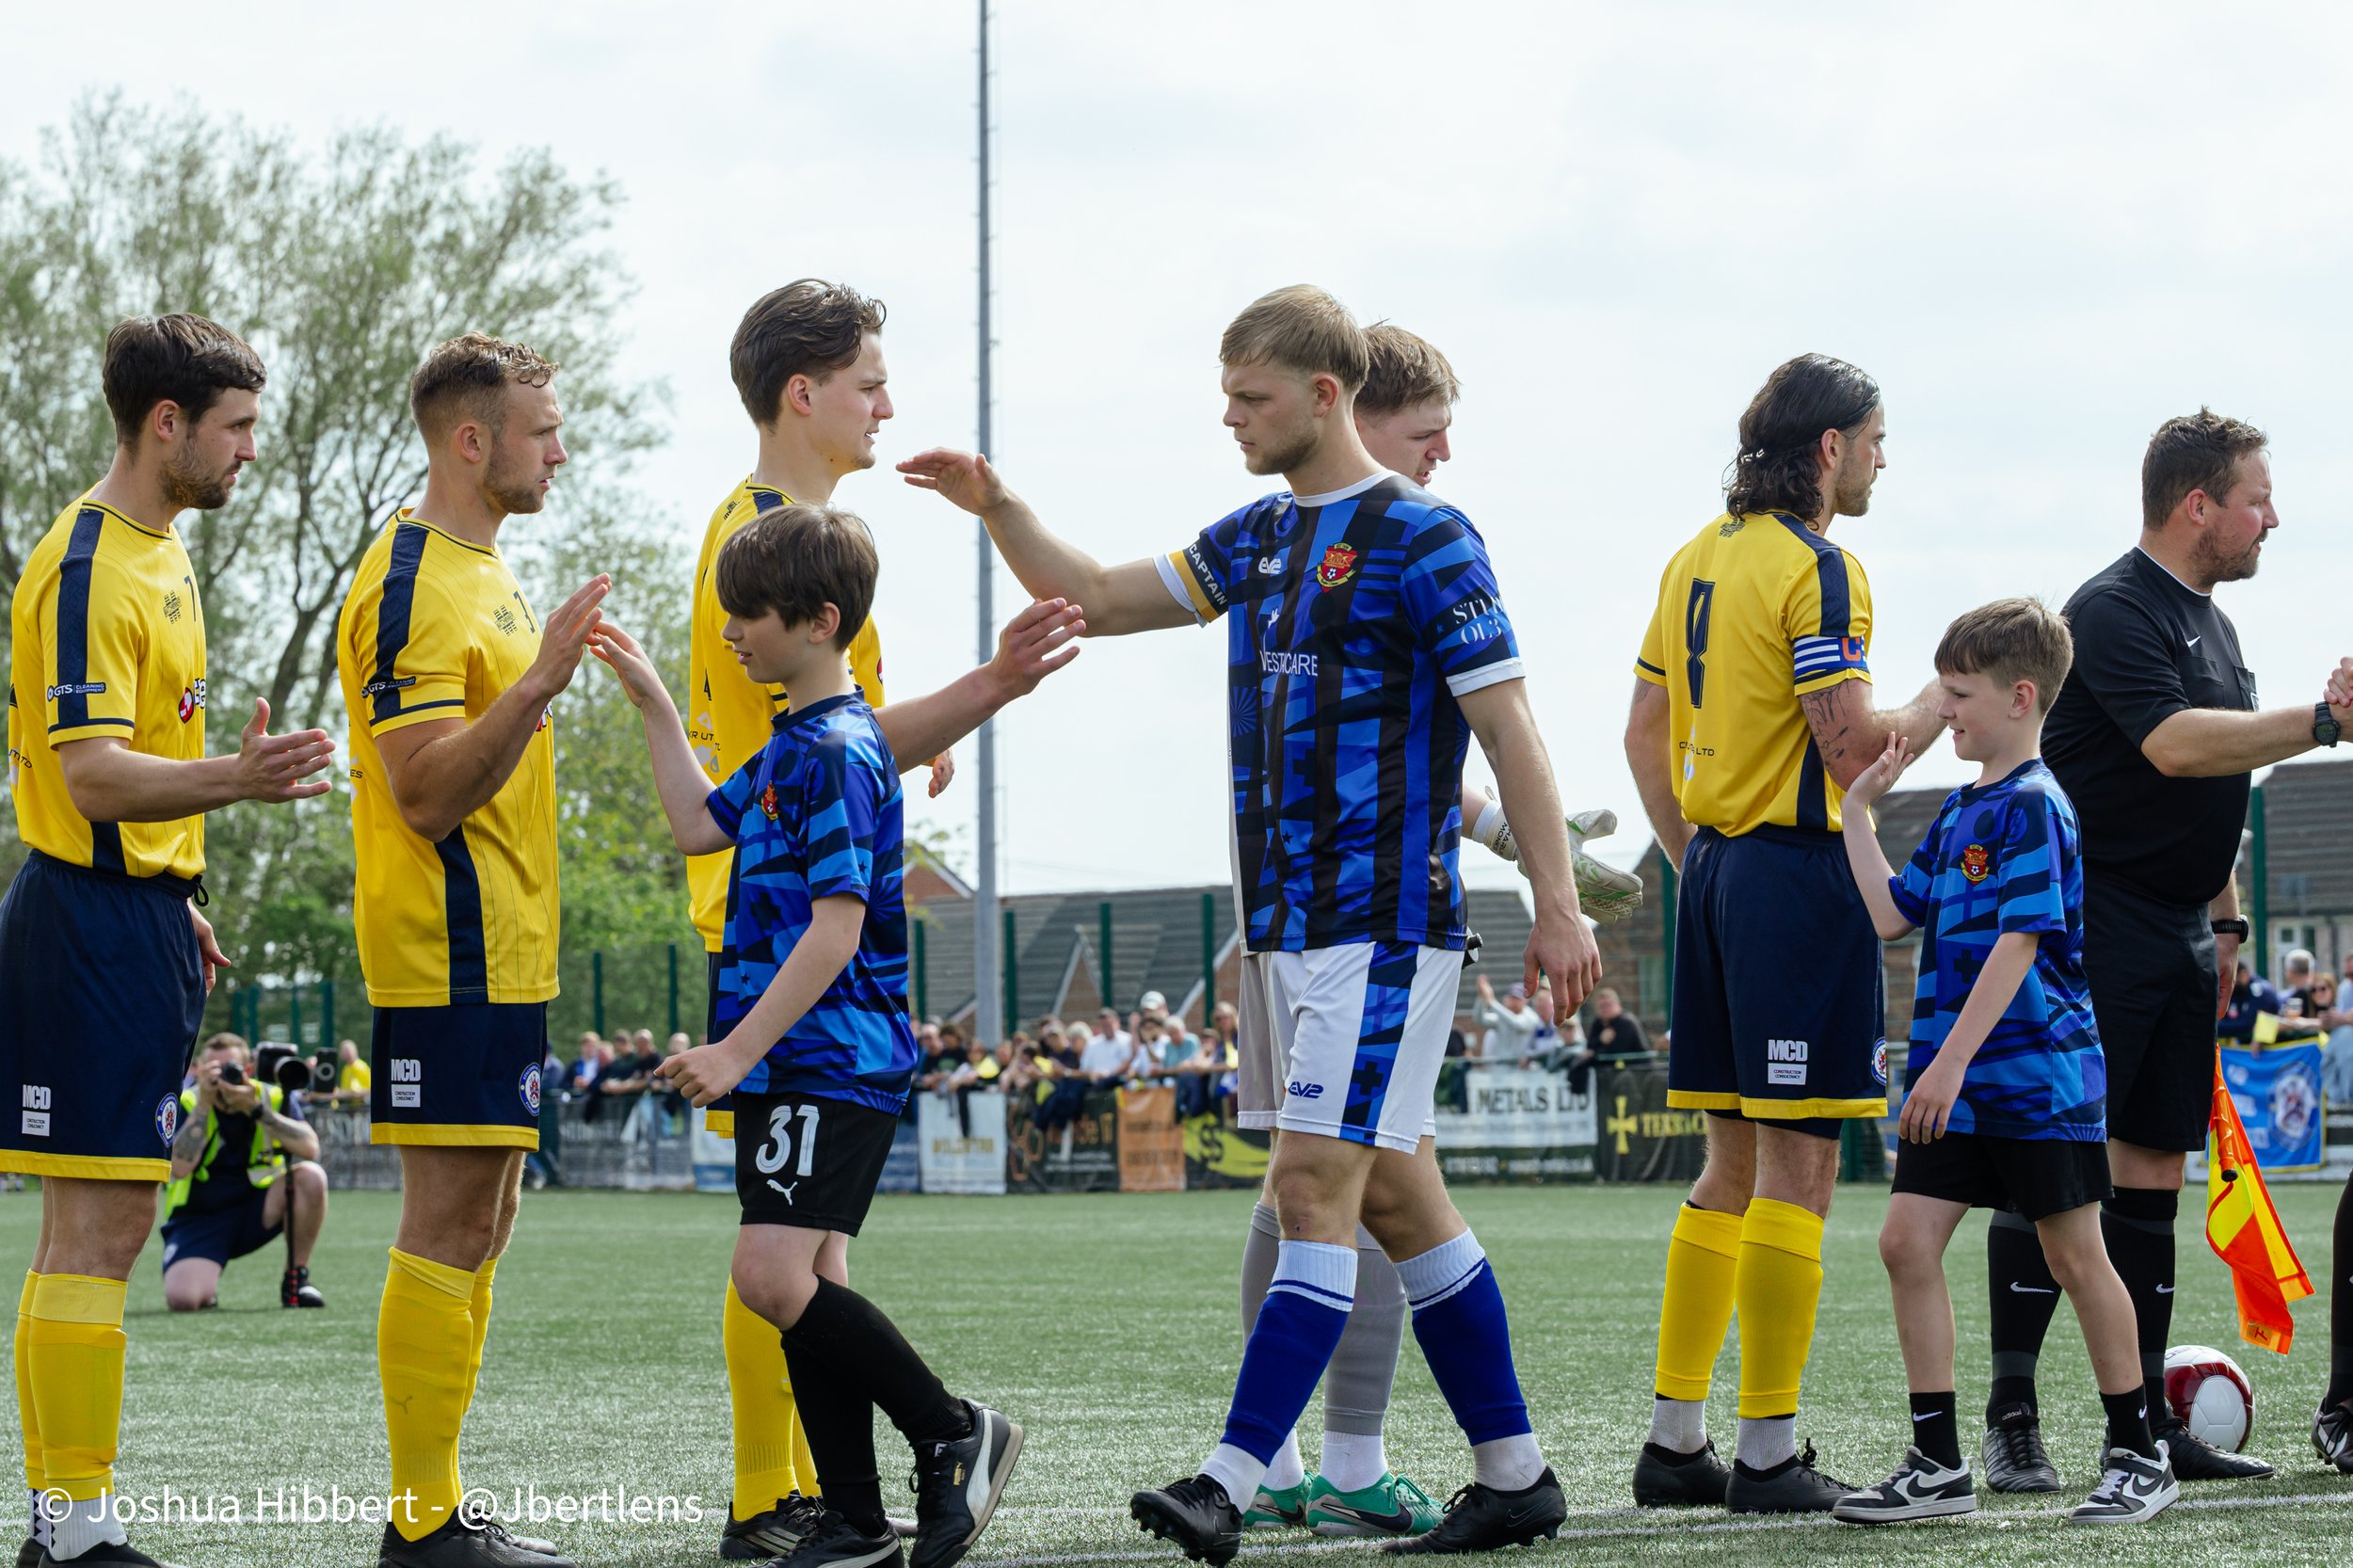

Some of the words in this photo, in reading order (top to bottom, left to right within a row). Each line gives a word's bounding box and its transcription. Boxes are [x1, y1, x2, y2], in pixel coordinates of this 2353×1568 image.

[1189, 543, 1227, 605] CAPTAIN
[1842, 636, 1862, 661] C
[54, 684, 73, 696] GTS
[368, 681, 386, 693] GTS
[1695, 746, 1715, 757] LTD
[1768, 1039, 1808, 1063] MCD
[391, 1058, 422, 1082] MCD
[22, 1084, 52, 1111] MCD
[1477, 1086, 1549, 1114] METALS
[755, 1104, 820, 1176] 31
